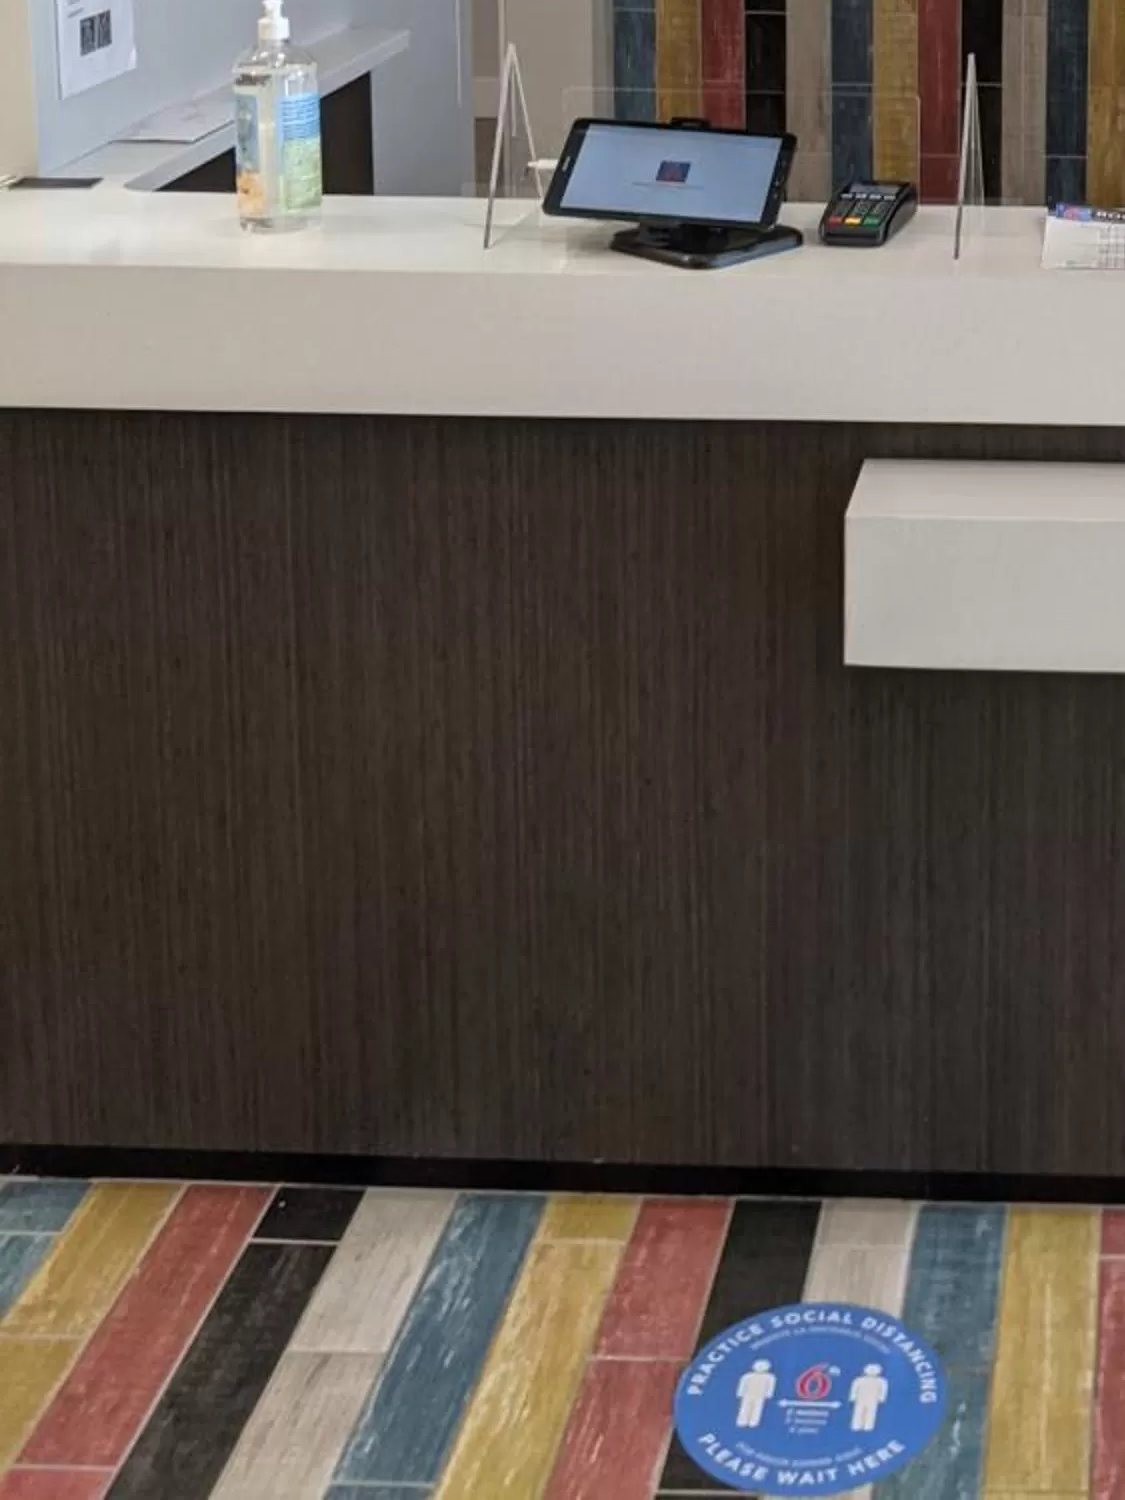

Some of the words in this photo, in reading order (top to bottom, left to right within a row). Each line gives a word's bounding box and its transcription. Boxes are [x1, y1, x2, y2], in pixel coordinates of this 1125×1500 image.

[687, 1323, 764, 1395] PRACTICE
[771, 1309, 852, 1328] SOCIAL
[860, 1315, 938, 1404] DISTANCING
[795, 1362, 832, 1400] 6
[697, 1432, 768, 1481] PLEASE
[777, 1467, 838, 1485] WAIT
[848, 1439, 906, 1476] HERE
